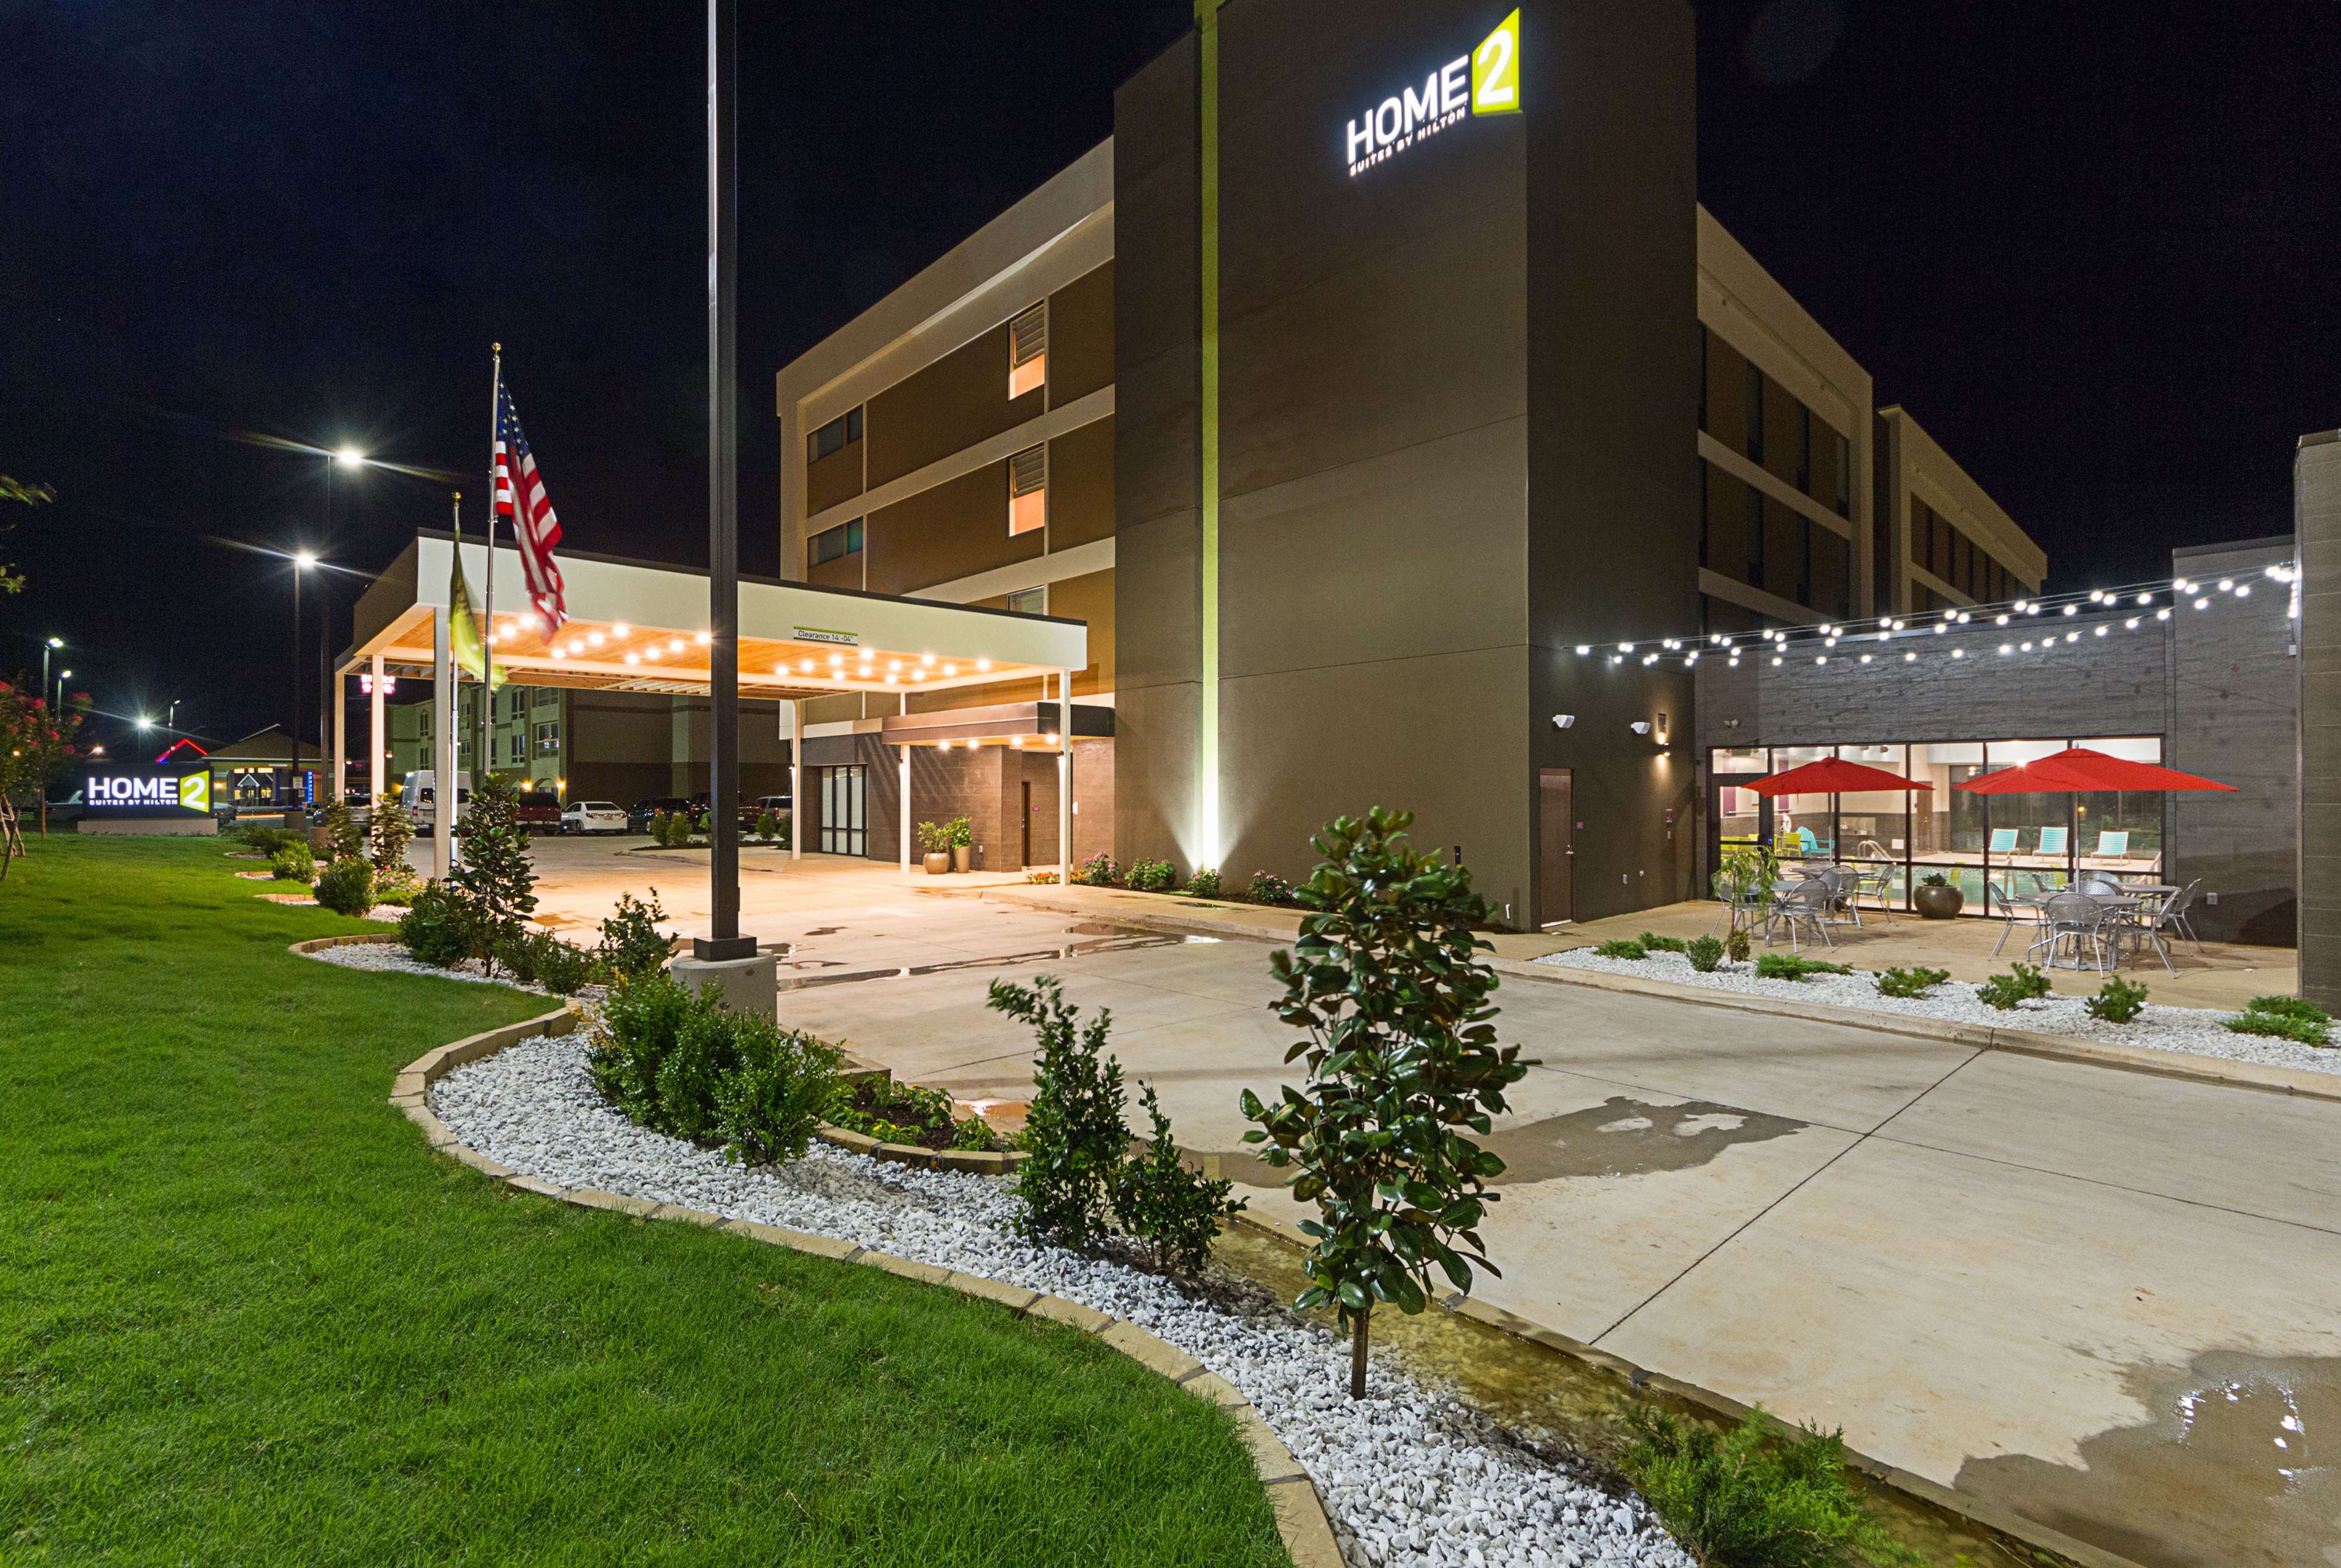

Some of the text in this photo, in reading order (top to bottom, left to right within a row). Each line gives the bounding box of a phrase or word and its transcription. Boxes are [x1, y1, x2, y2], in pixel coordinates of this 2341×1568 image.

[1349, 107, 1465, 177] SUITES BY HILTON
[798, 630, 830, 640] Clearance
